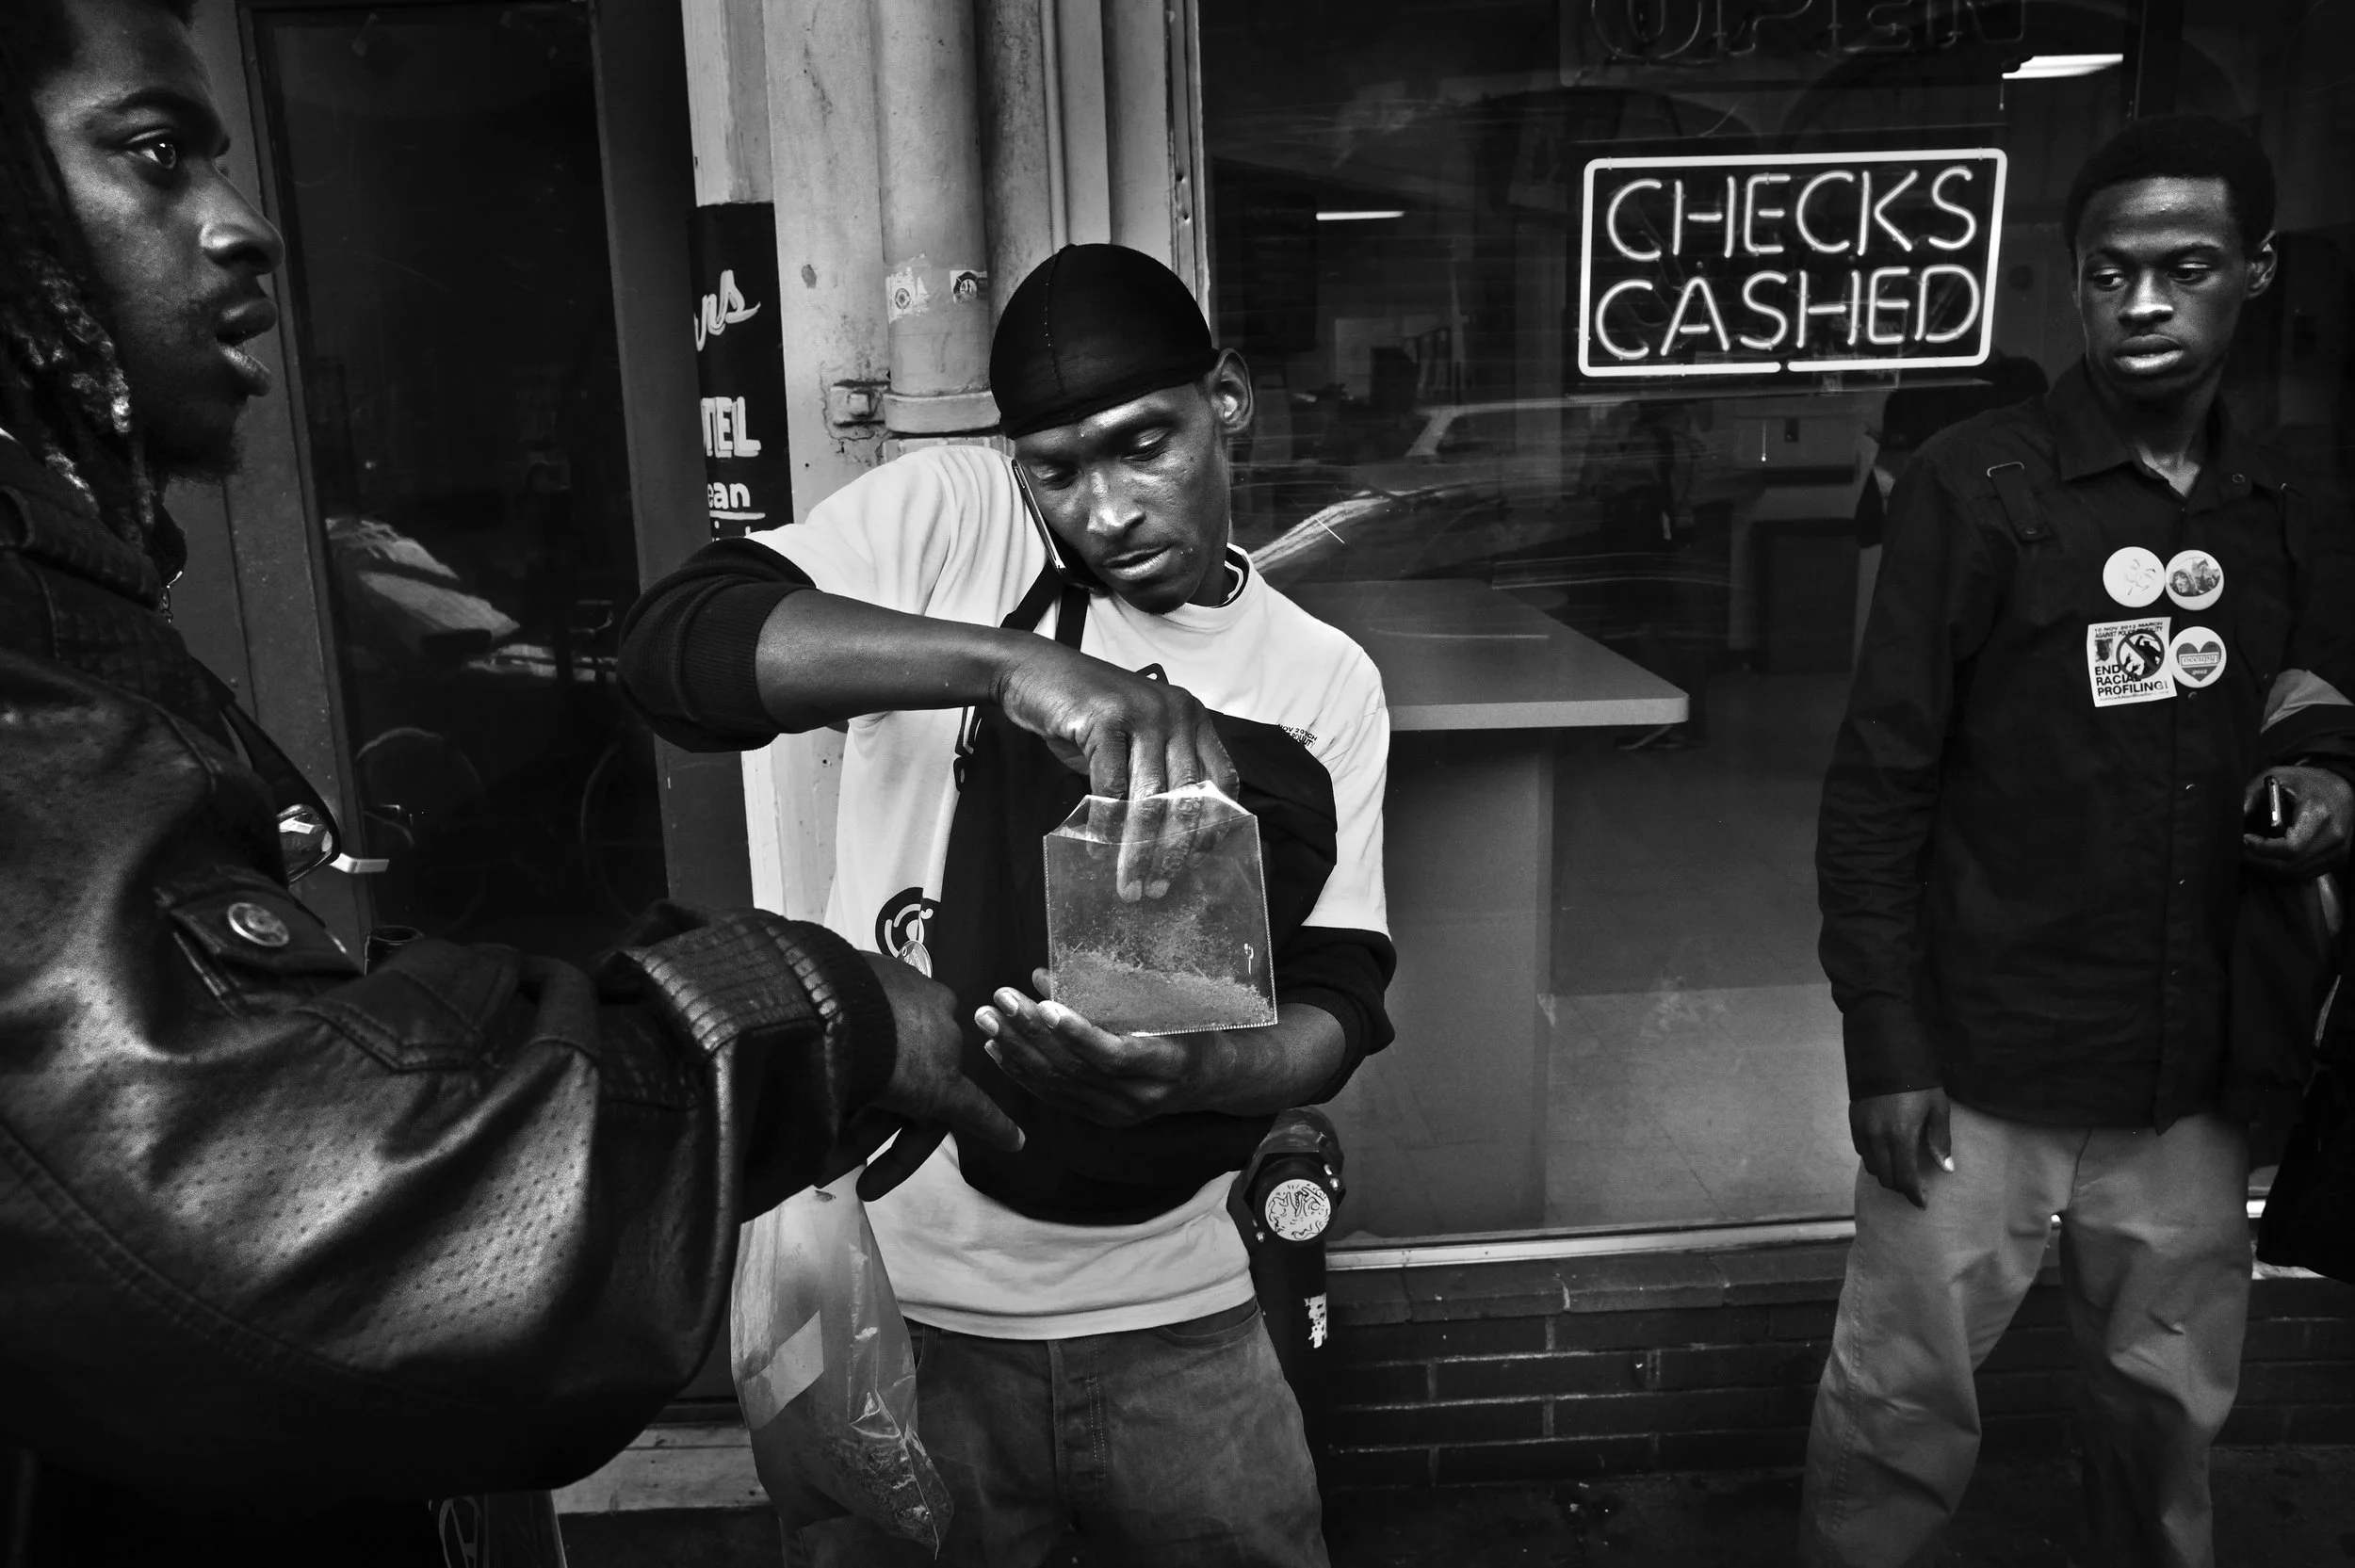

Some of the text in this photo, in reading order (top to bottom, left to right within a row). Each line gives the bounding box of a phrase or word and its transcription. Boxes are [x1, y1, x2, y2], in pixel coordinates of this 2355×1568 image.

[1607, 167, 1976, 262] CHECKS
[1596, 265, 1980, 360] CASHED
[2094, 664, 2121, 675] END
[2097, 679, 2168, 697] PROFILING!
